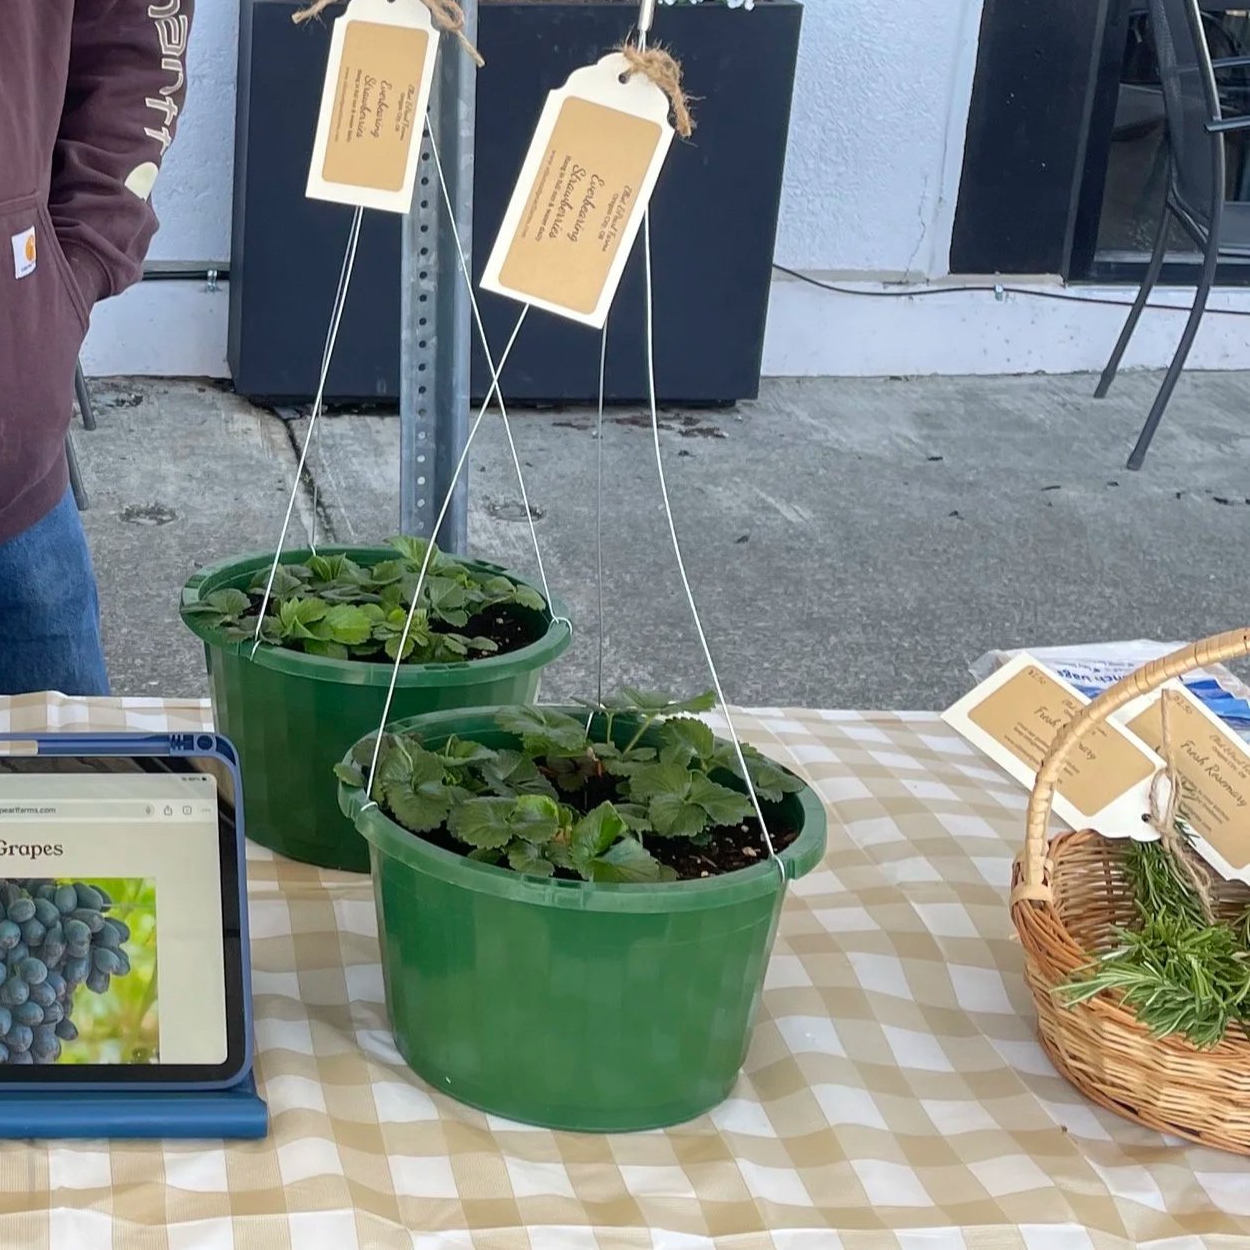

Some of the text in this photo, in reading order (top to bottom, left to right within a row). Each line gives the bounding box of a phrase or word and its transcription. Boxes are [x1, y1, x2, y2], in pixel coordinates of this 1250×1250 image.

[355, 74, 377, 138] Strawberries
[370, 79, 393, 138] Everbearing
[548, 164, 587, 239] Strawberries
[566, 173, 606, 242] Everbearing
[1034, 706, 1062, 728] Fresh
[1180, 740, 1210, 766] Fresh
[1204, 763, 1247, 807] Rosemary
